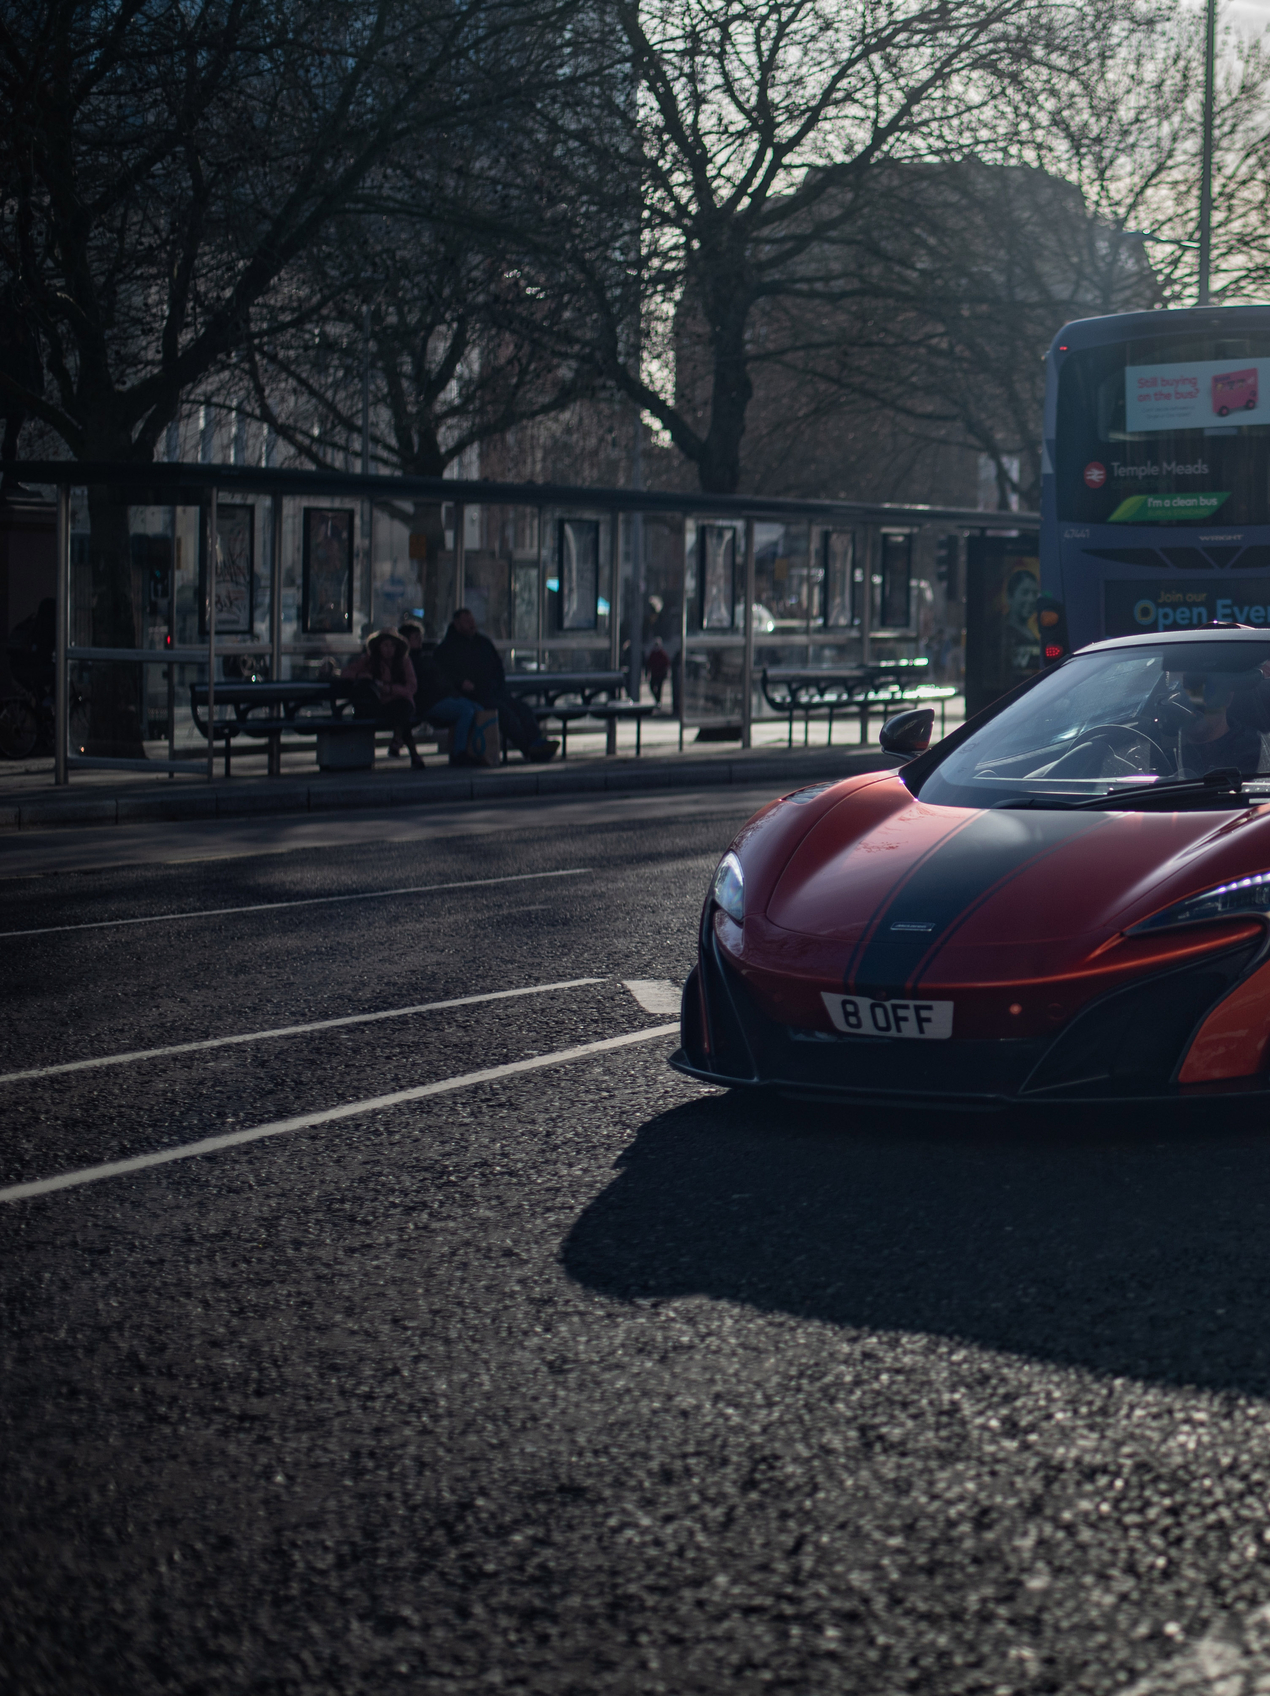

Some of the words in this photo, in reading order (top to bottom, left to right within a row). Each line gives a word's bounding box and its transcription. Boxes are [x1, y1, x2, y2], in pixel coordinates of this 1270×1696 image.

[1137, 377, 1158, 388] Still
[1160, 375, 1198, 389] buying
[1137, 393, 1151, 402] on
[1153, 390, 1171, 401] the
[1174, 388, 1200, 400] bus?
[1110, 460, 1159, 480] Temple
[1162, 459, 1209, 476] Meads
[1147, 497, 1162, 507] I'm
[1163, 499, 1170, 507] a
[1171, 497, 1198, 507] clean
[1199, 496, 1218, 506] bus
[1199, 533, 1245, 541] WRIGHT
[1158, 591, 1183, 603] Join
[1186, 592, 1207, 602] our
[1134, 599, 1207, 631] Open
[841, 998, 862, 1029] 8
[869, 1001, 934, 1034] OFF
